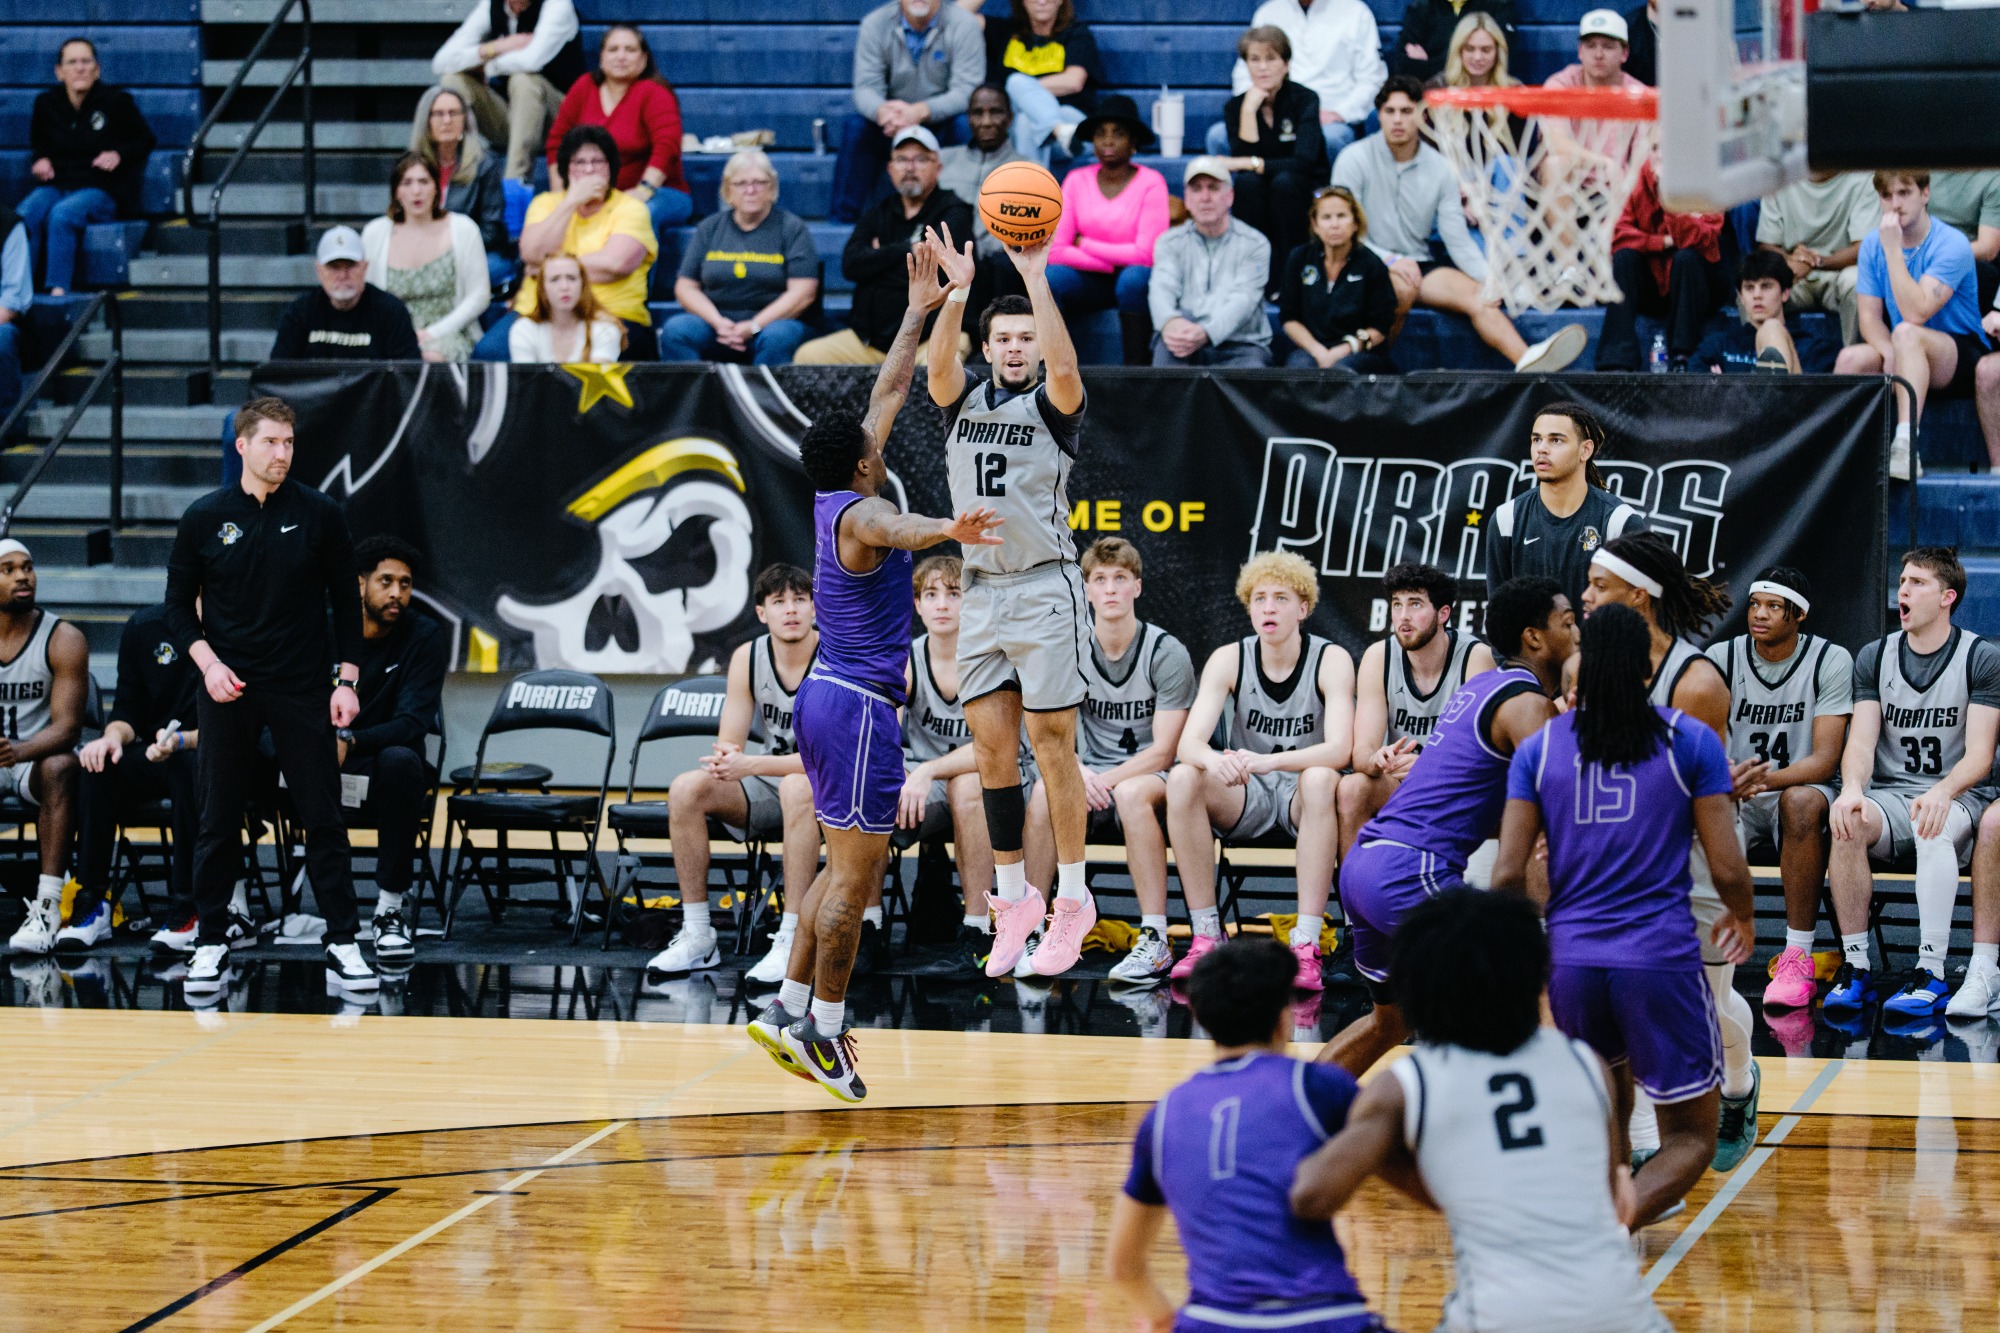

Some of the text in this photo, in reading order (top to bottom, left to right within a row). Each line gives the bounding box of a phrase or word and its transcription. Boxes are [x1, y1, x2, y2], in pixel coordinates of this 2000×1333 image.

[1000, 203, 1041, 218] NCAA
[991, 221, 1046, 241] Wilson
[957, 418, 1036, 446] PIRATES
[974, 452, 1008, 497] 12
[1141, 500, 1206, 532] OF
[0, 681, 44, 700] ATES
[506, 681, 598, 710] PIRATES
[660, 688, 726, 717] PIRAT
[1246, 708, 1315, 738] PIRATES
[1885, 702, 1959, 728] PIRATES
[1117, 731, 1140, 755] 4
[1749, 731, 1791, 770] 34
[1900, 736, 1943, 775] 33
[1573, 752, 1637, 825] 15
[1488, 1072, 1544, 1151] 2
[1208, 1096, 1242, 1181] 1
